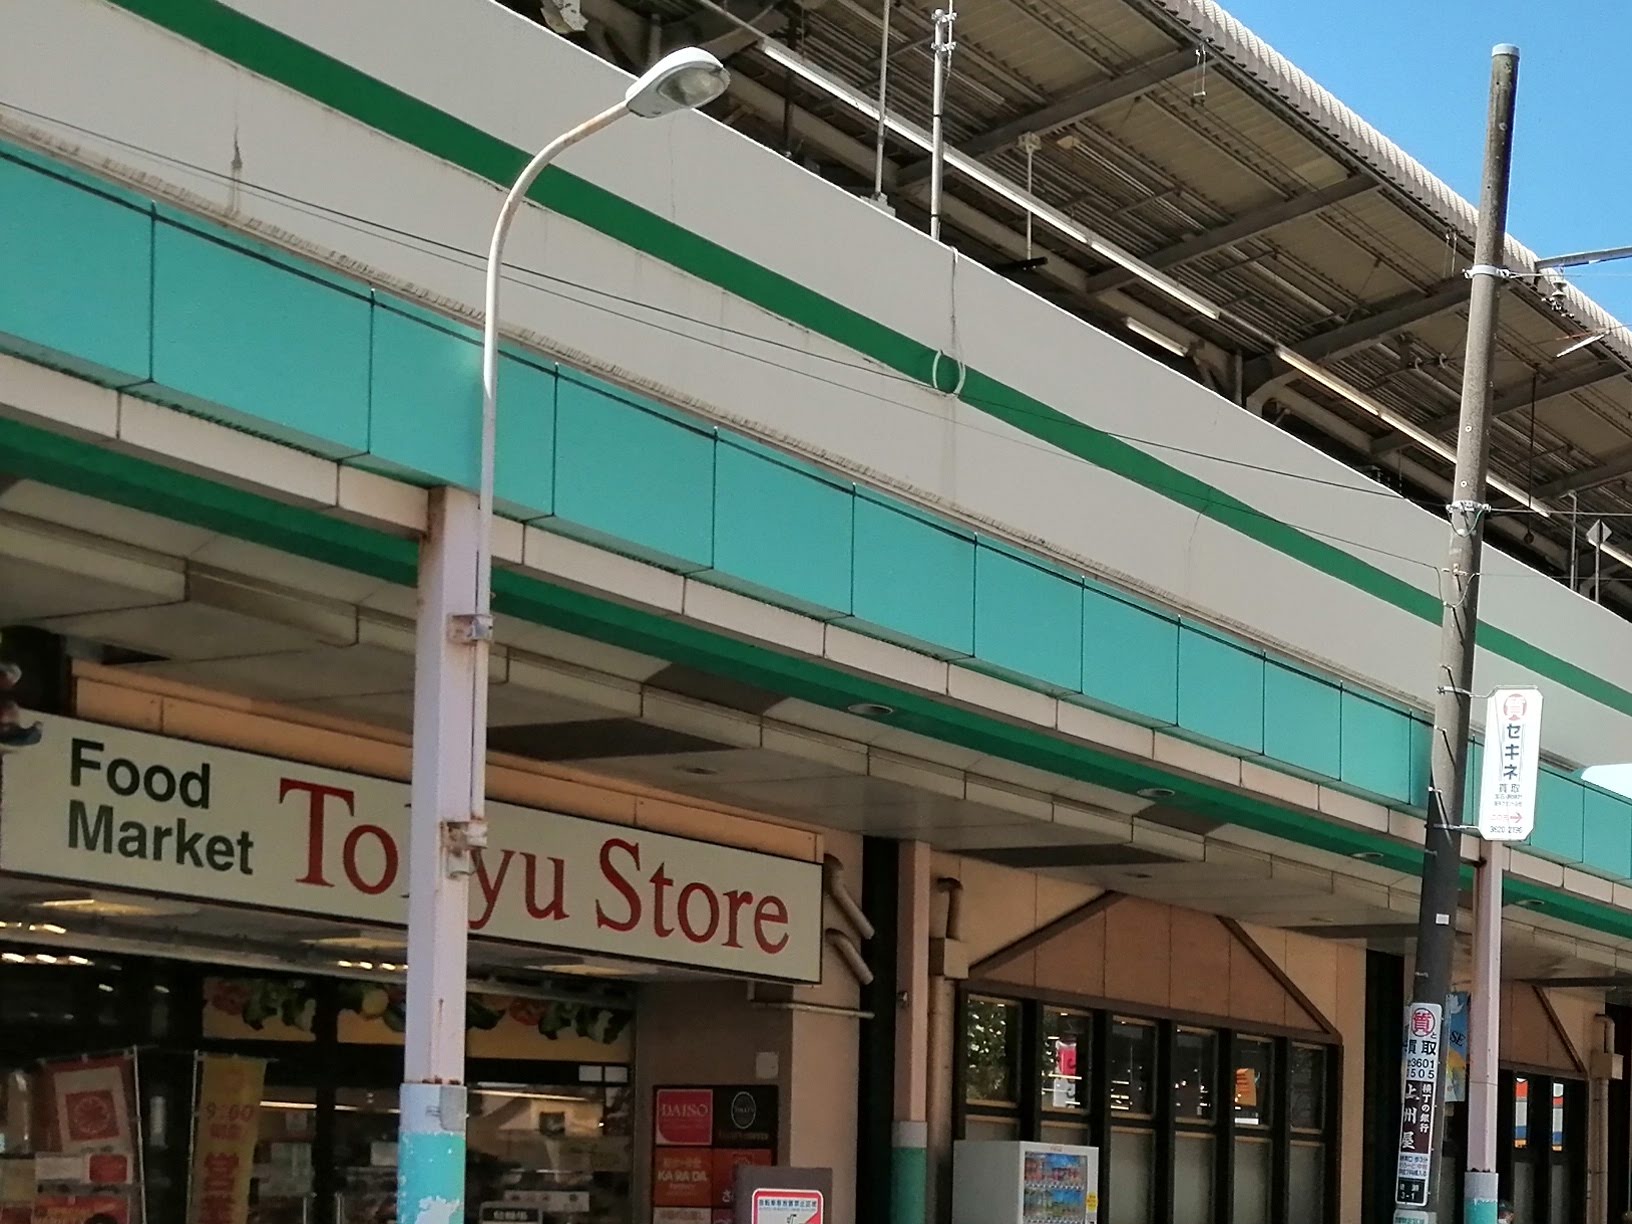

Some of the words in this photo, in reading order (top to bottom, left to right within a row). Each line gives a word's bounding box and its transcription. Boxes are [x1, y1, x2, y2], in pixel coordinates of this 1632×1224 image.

[70, 737, 210, 810] Food
[1503, 723, 1521, 780] セキネ
[67, 799, 254, 875] Market
[278, 777, 570, 930] Toyu
[595, 837, 790, 955] Store
[662, 1103, 709, 1118] DAISO
[1402, 1083, 1420, 1150] 上州屋
[1419, 1083, 1433, 1134] 横丁の銀行
